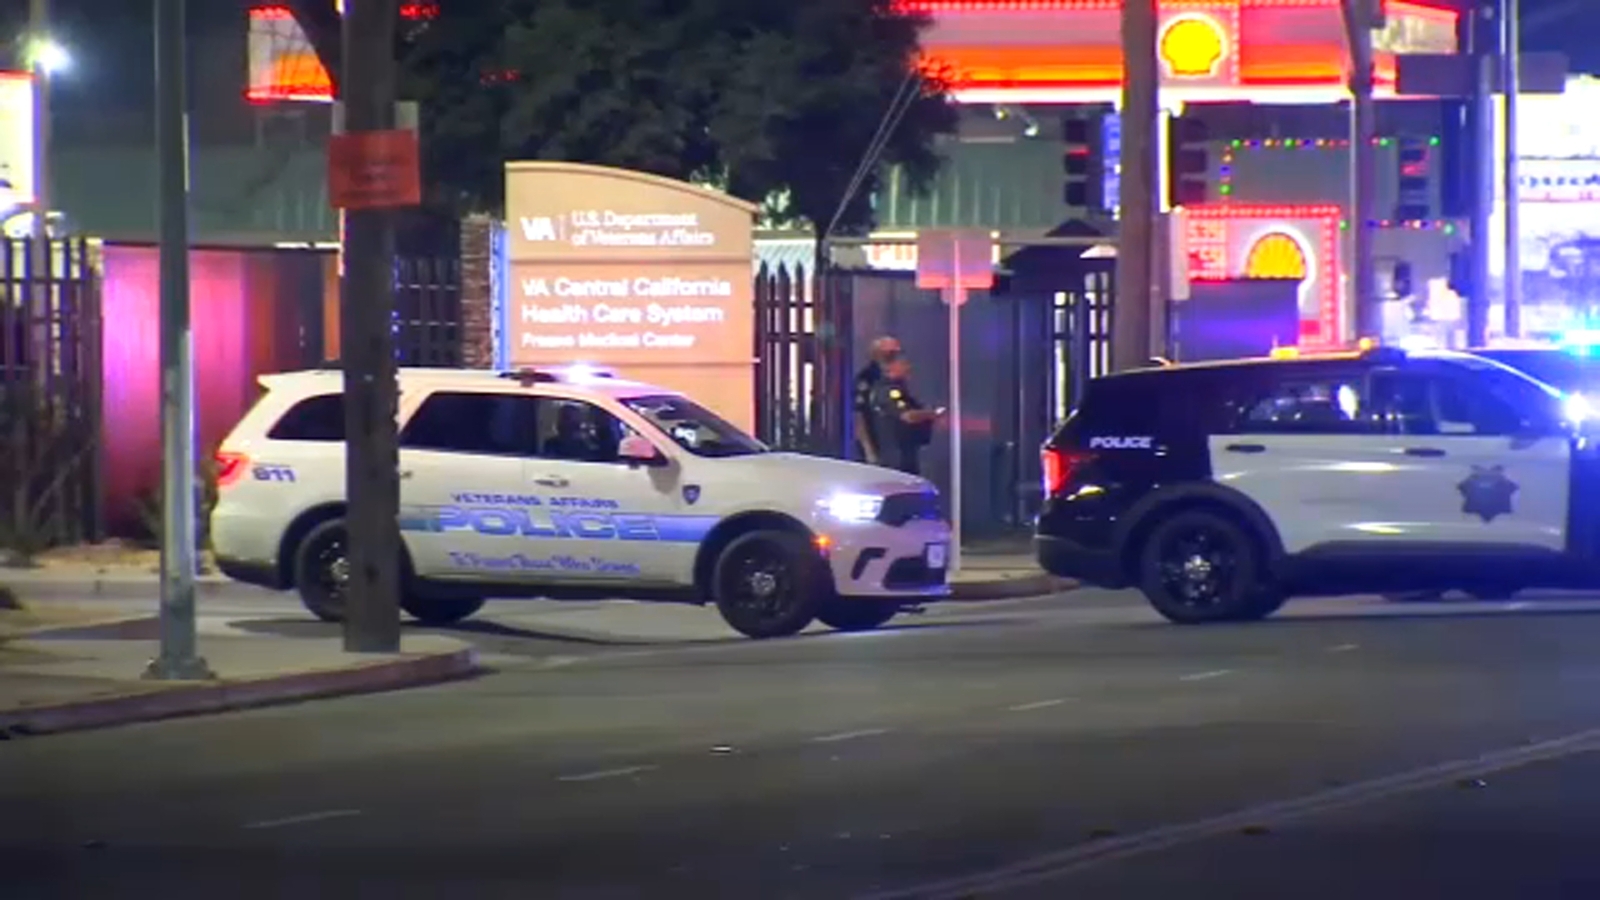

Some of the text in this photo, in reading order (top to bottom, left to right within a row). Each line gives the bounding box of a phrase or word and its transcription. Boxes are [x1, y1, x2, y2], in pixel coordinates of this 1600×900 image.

[520, 216, 556, 241] VA
[603, 210, 697, 230] Department
[656, 228, 715, 246] Affairs
[521, 277, 732, 297] VA Central California
[521, 303, 725, 327] Health Care System
[578, 332, 640, 348] Medical
[642, 332, 696, 348] Center
[1089, 435, 1154, 449] POLICE
[450, 493, 619, 510] VETERANS AFFAIRS
[432, 505, 661, 542] POLICE
